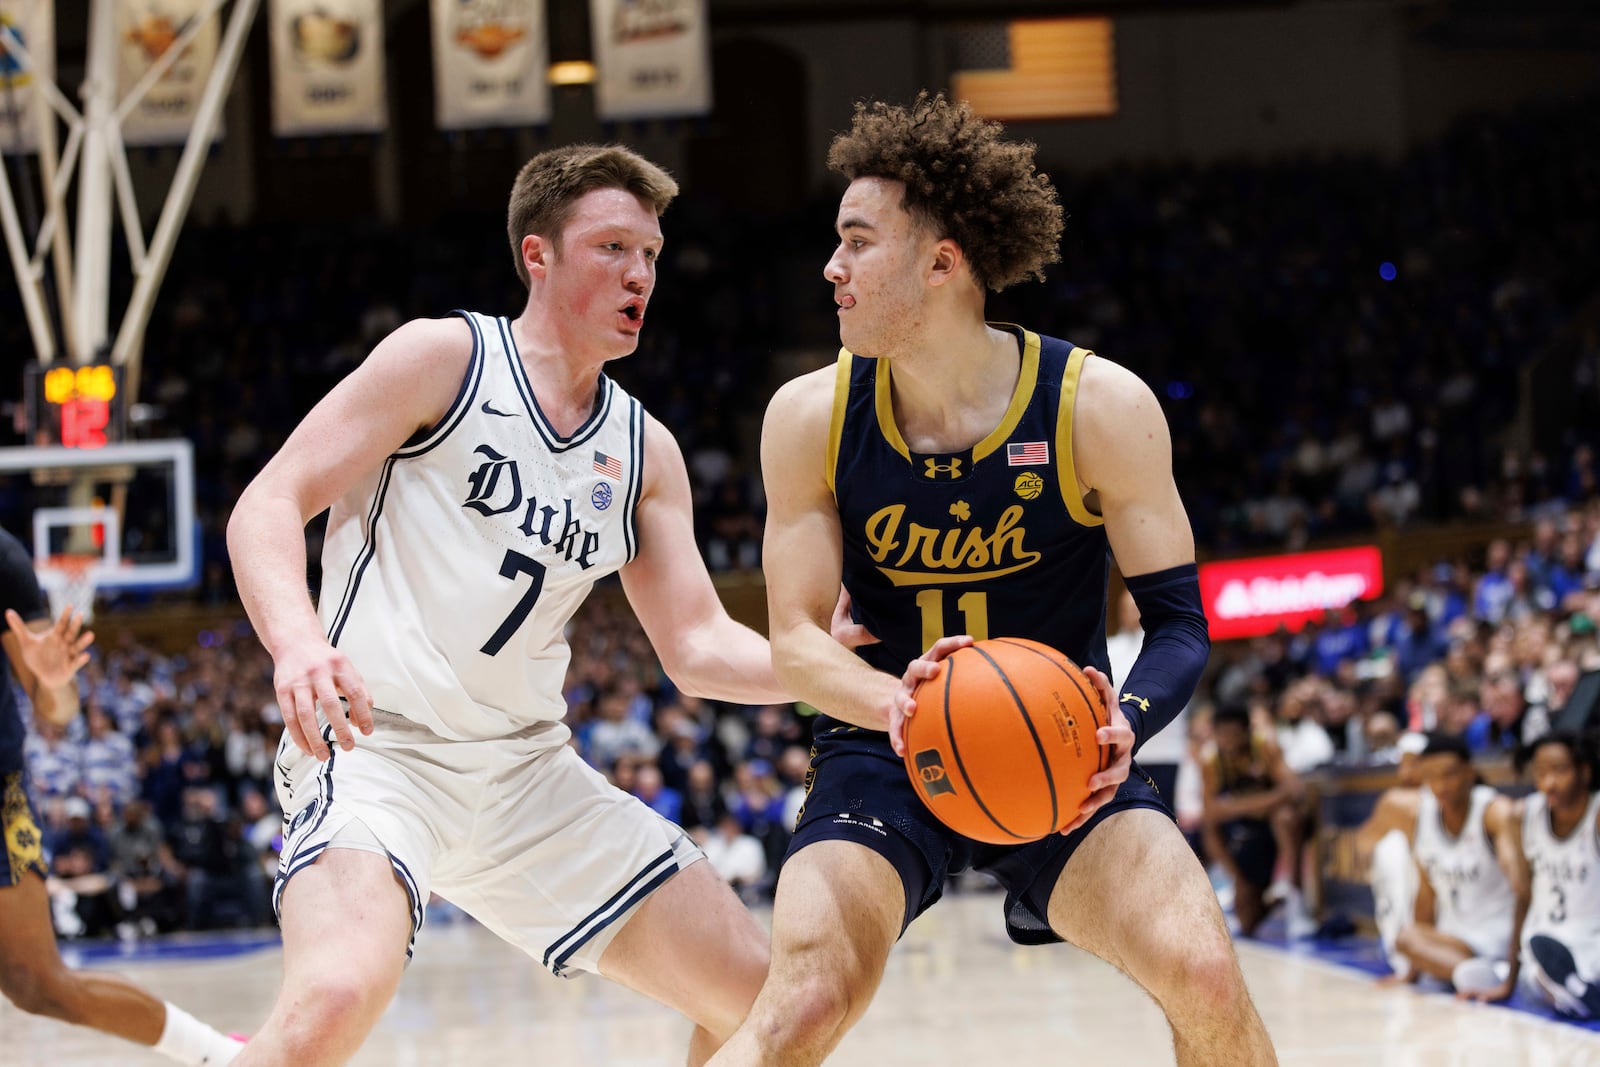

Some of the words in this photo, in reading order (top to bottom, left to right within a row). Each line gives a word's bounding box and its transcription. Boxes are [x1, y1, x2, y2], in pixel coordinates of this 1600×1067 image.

[462, 444, 599, 571] Duke
[865, 503, 1042, 569] Irish
[479, 548, 547, 657] 7
[915, 588, 989, 655] 11
[858, 821, 887, 836] ARMOUR
[1549, 884, 1566, 923] 3
